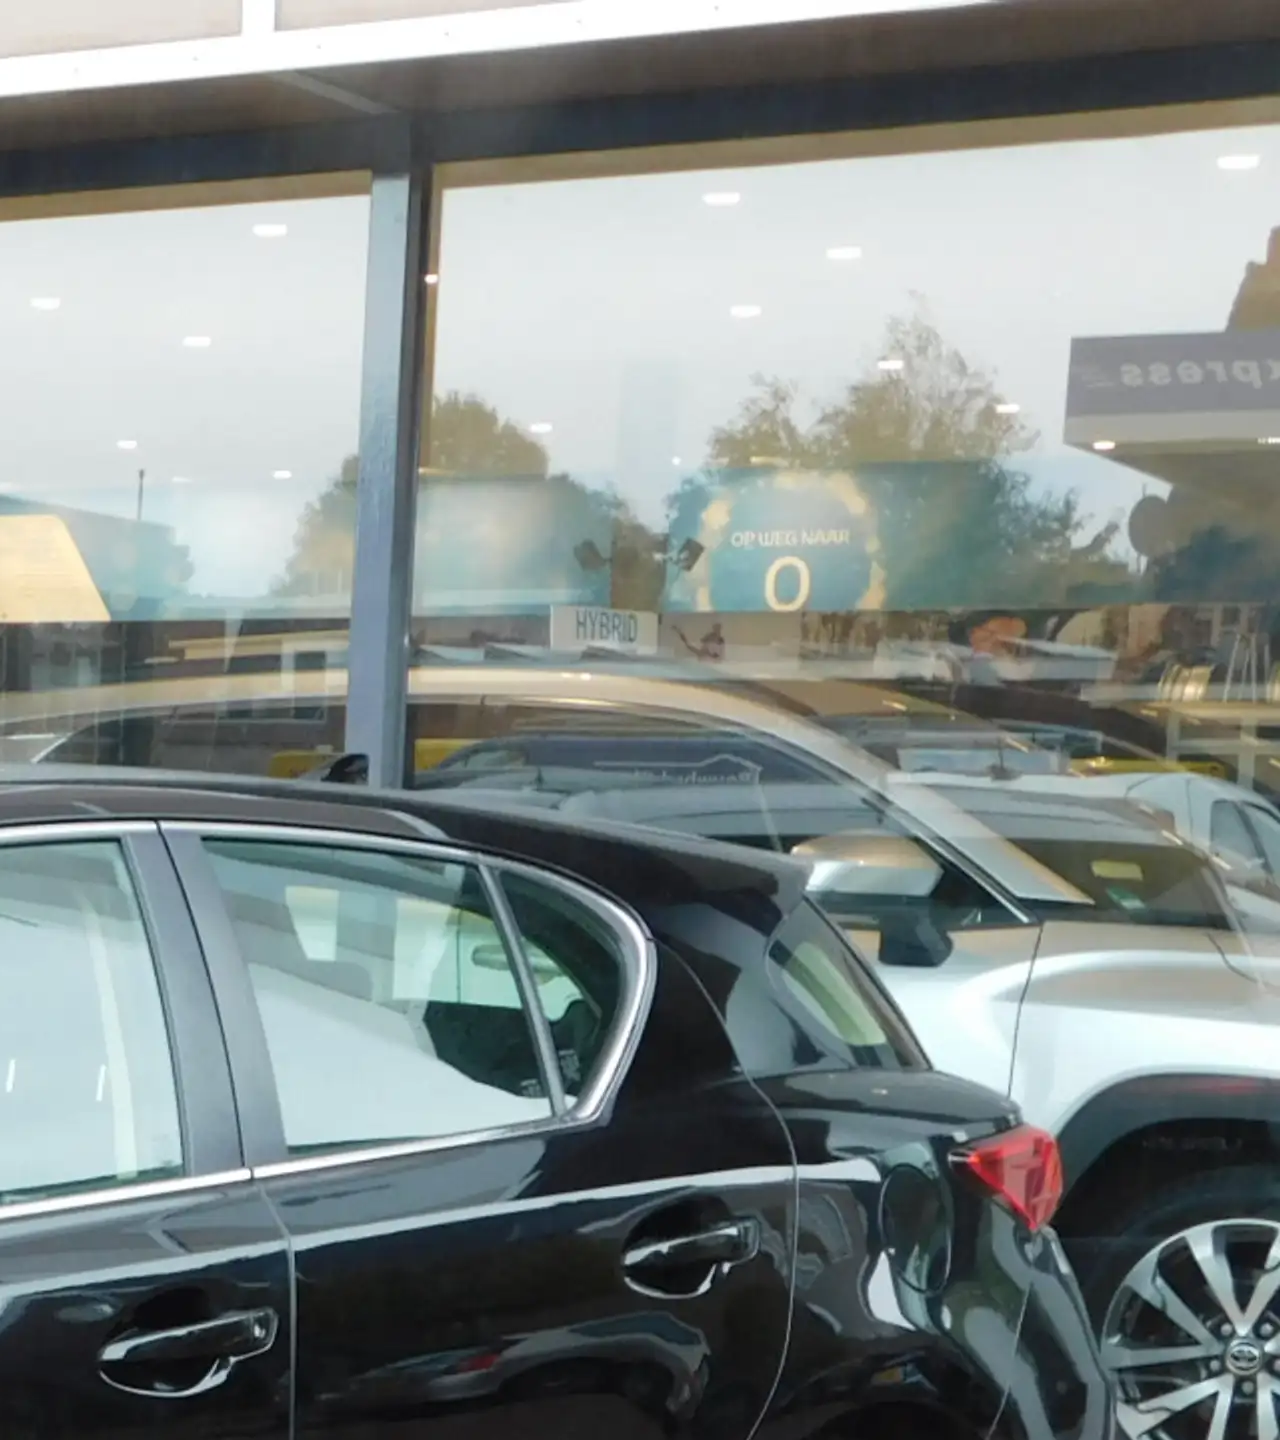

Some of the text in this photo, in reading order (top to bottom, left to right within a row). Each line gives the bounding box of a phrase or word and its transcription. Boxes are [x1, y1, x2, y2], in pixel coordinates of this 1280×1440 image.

[730, 529, 850, 547] OP WEG NAAR
[575, 610, 639, 643] HYBRID
